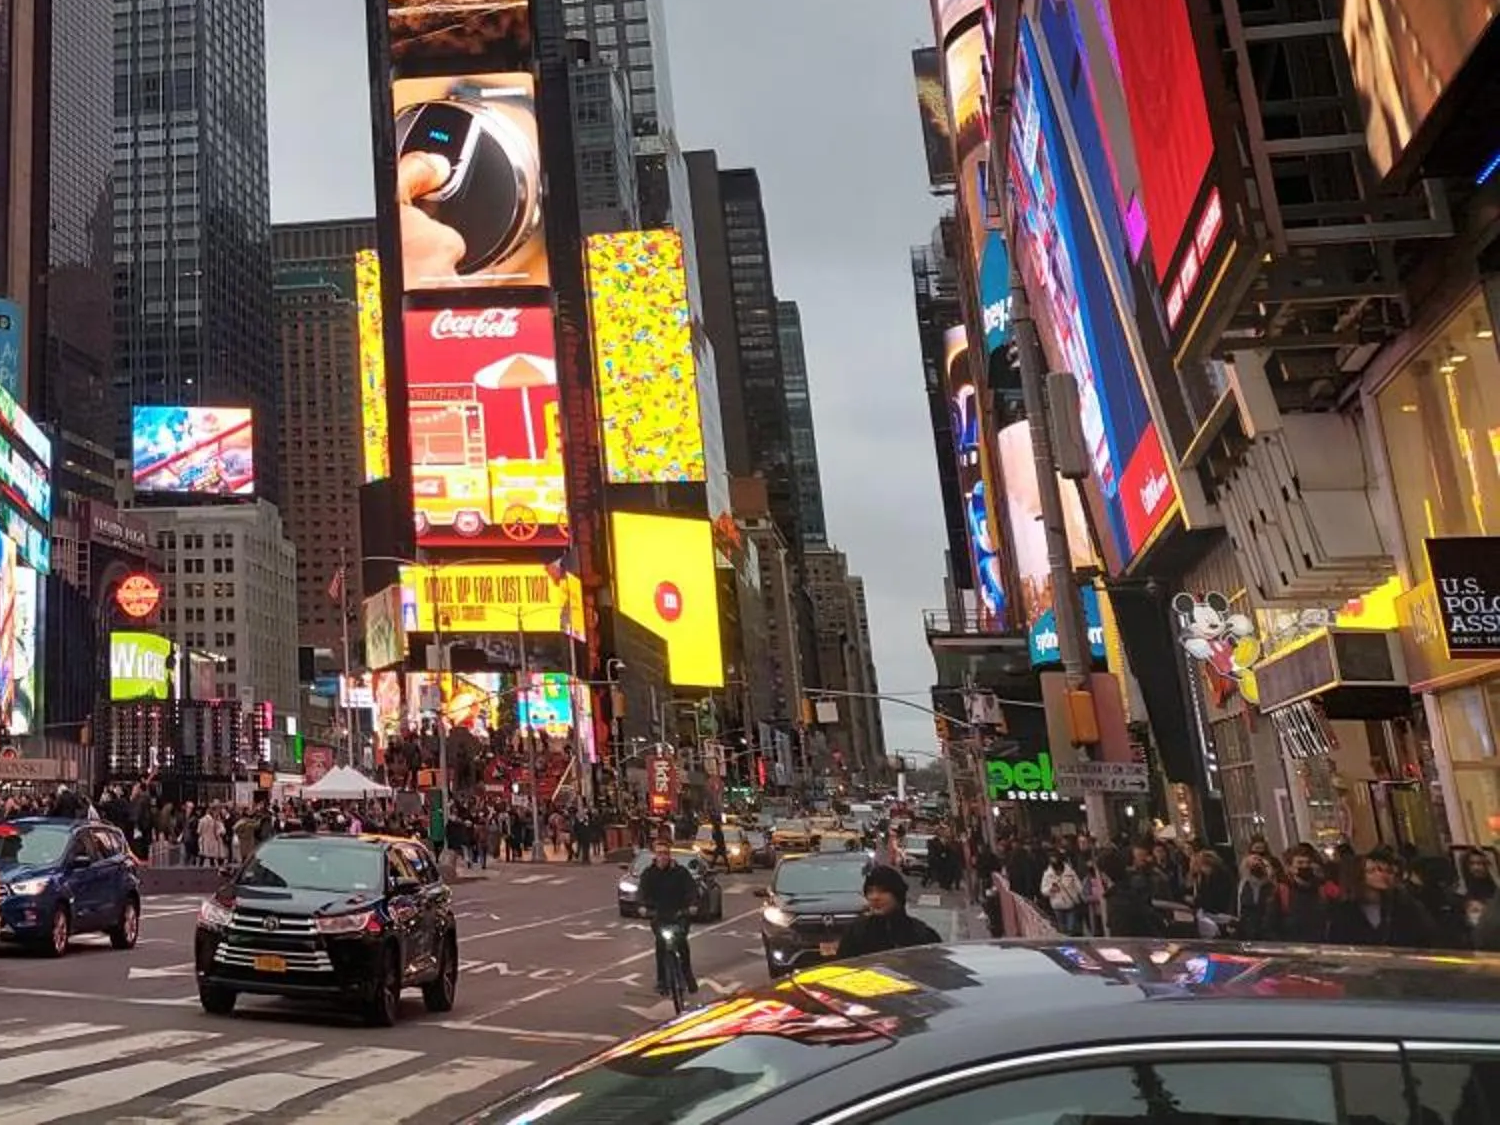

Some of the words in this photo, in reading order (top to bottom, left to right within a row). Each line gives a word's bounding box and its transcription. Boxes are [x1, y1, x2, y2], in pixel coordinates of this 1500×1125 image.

[430, 308, 524, 340] Coca-Cola
[1440, 577, 1486, 595] U.S.
[986, 752, 1055, 802] pel
